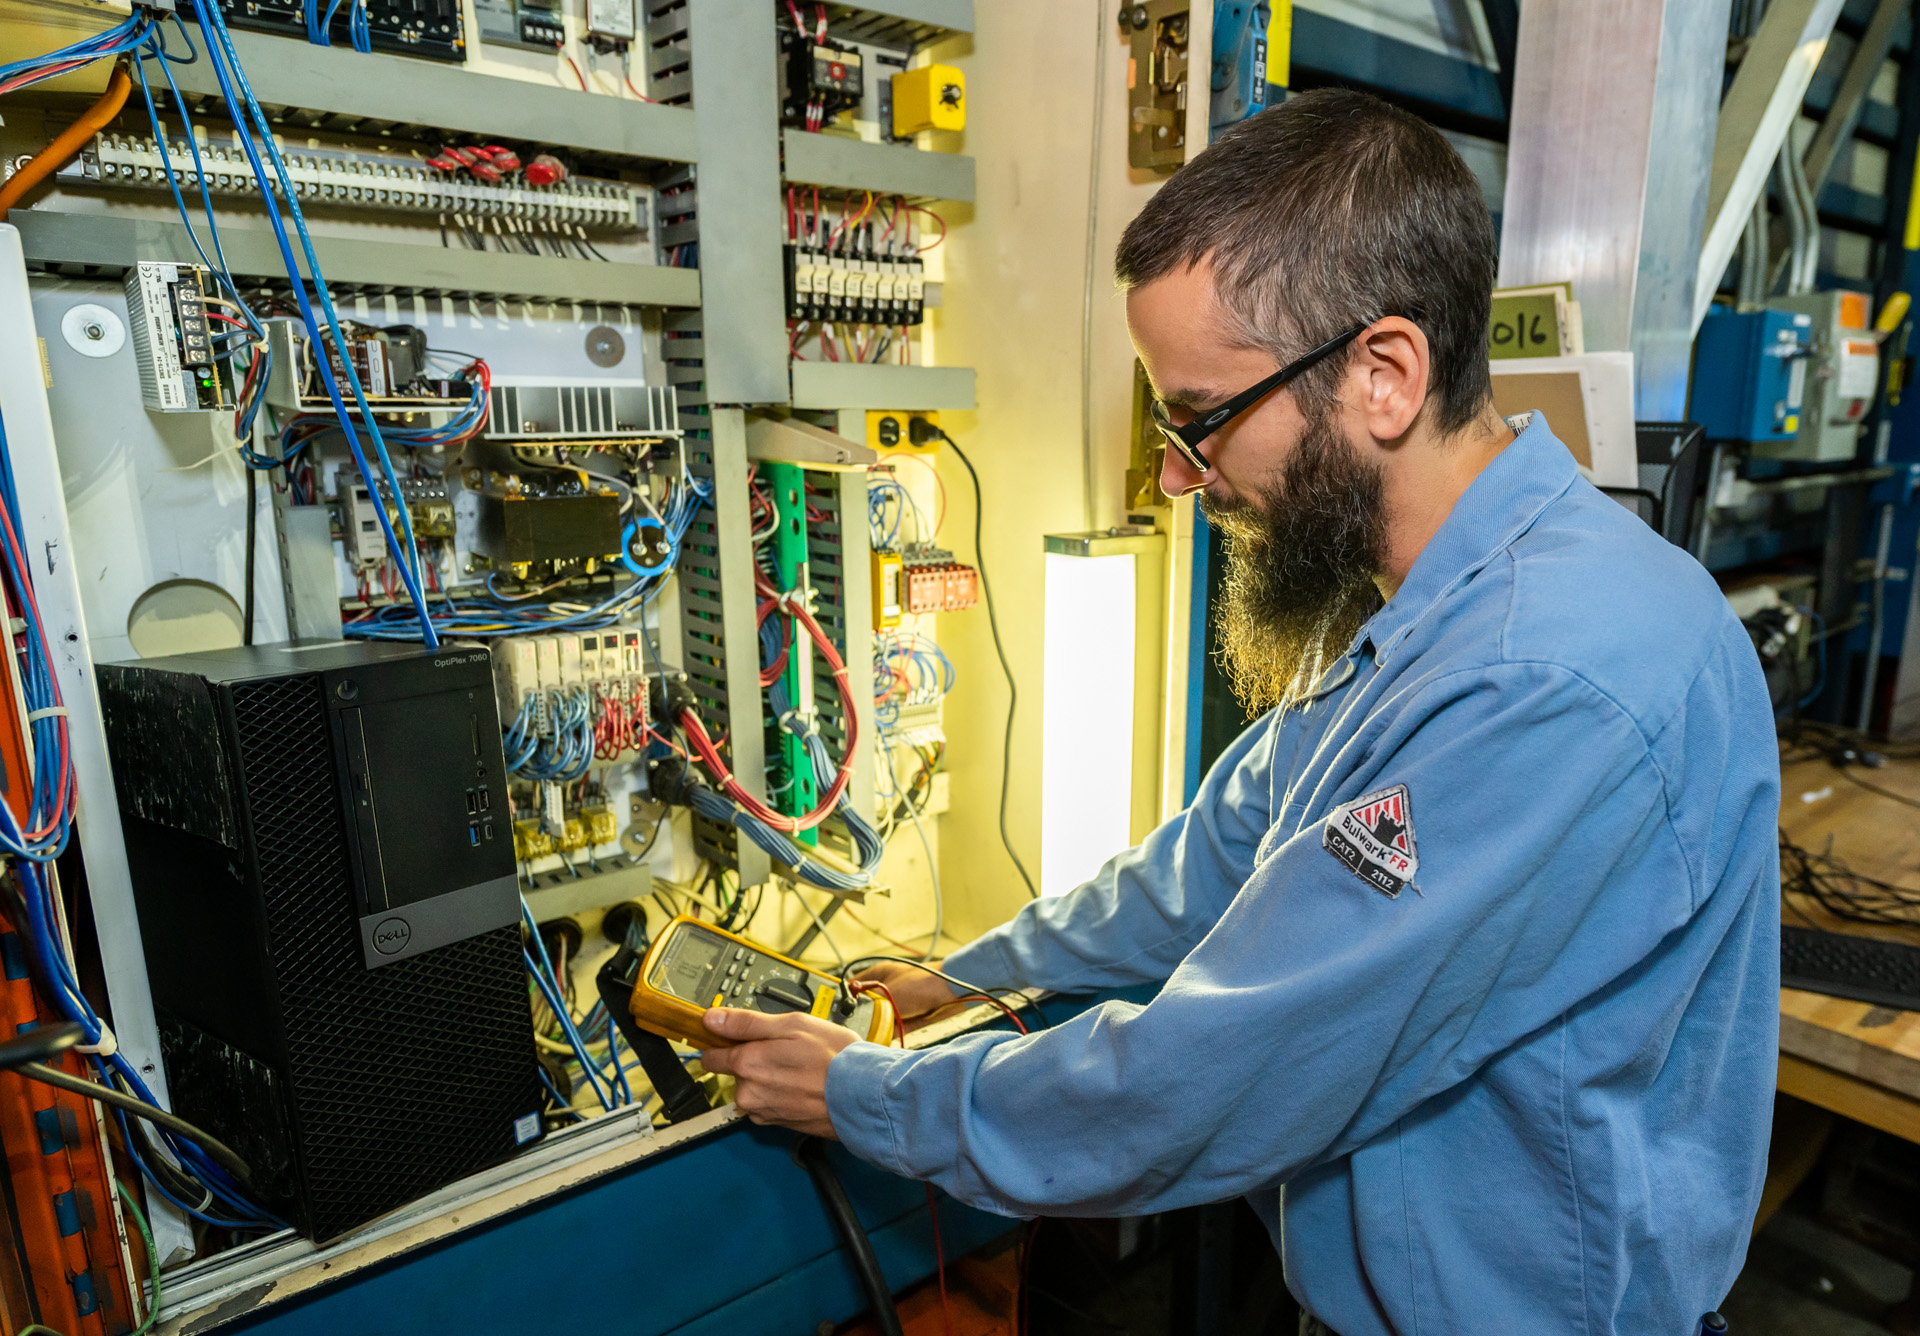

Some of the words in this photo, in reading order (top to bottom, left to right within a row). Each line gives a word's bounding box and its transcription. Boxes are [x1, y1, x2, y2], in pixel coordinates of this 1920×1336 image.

[434, 656, 467, 668] OptiPlex
[468, 653, 488, 662] 7060
[1332, 836, 1356, 861] CAT2
[1389, 853, 1409, 872] FR
[1371, 869, 1394, 889] 2112
[377, 928, 408, 945] DELL
